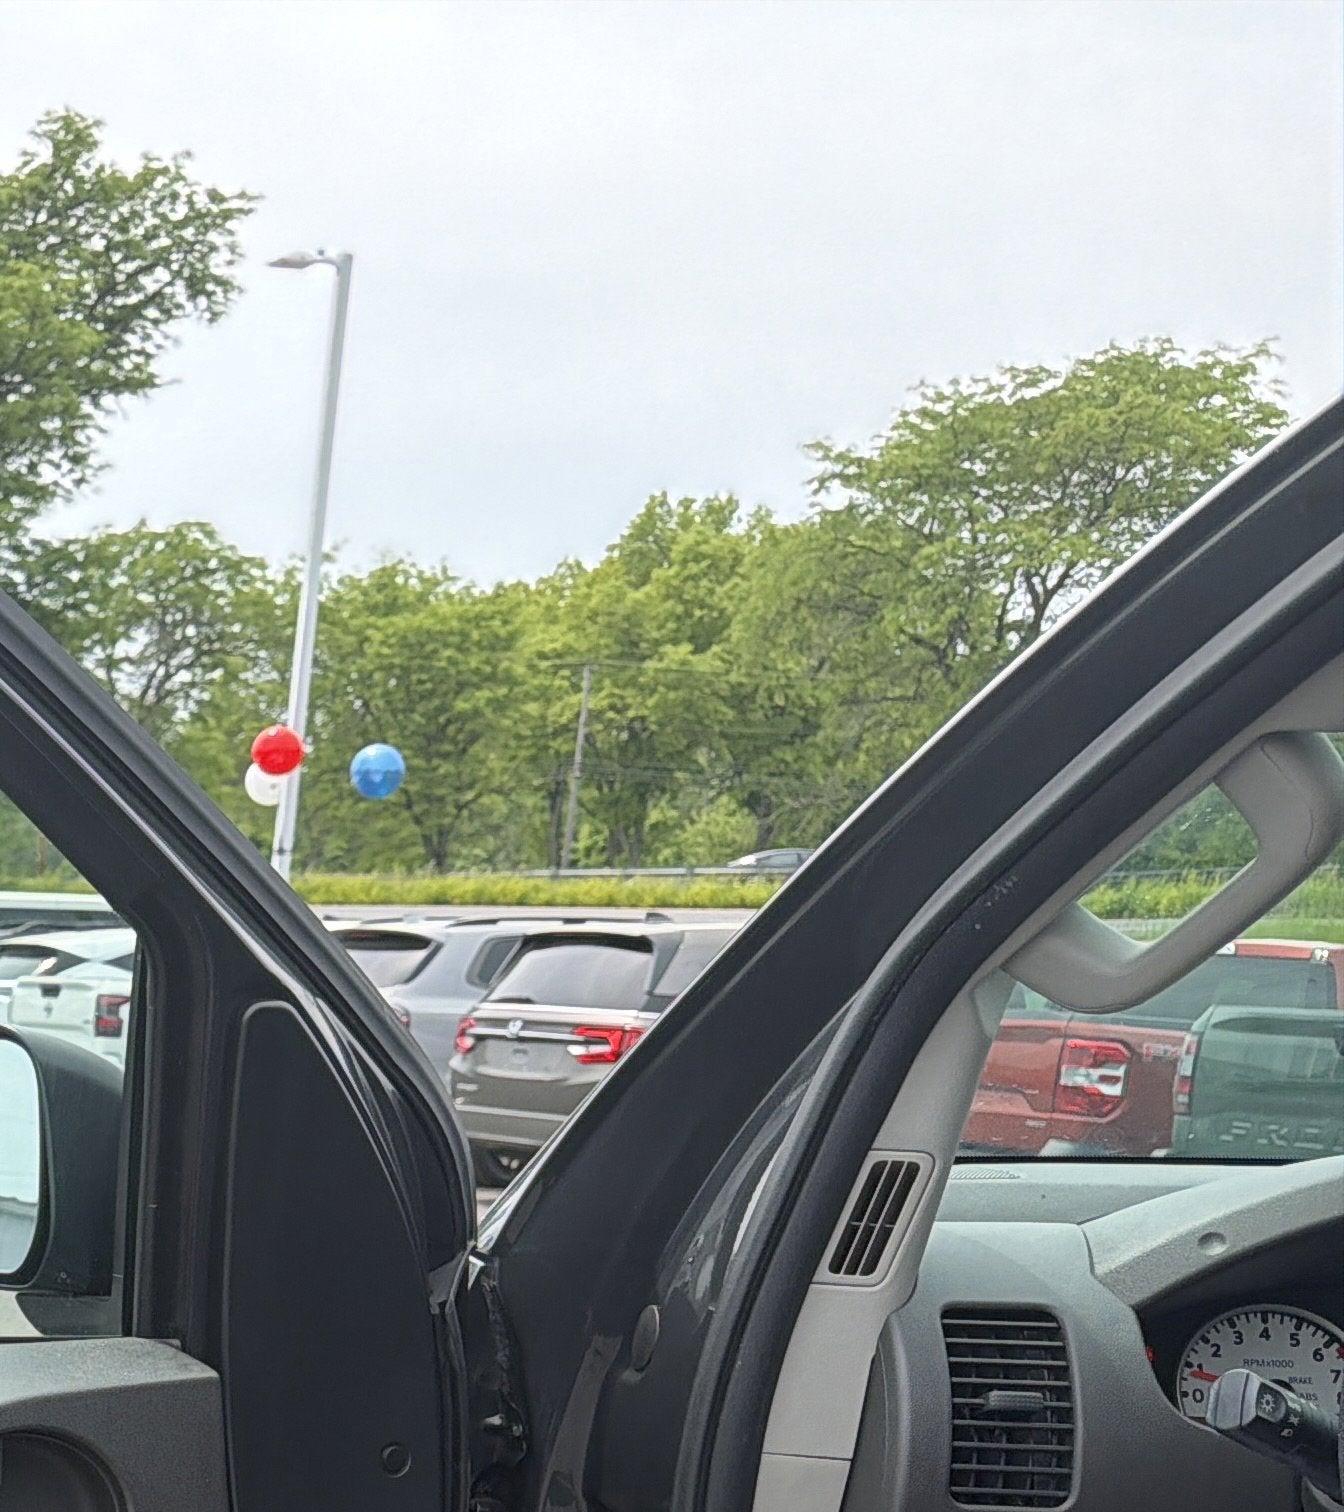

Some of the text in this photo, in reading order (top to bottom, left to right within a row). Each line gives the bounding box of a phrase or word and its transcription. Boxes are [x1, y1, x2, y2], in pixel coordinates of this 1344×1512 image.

[1232, 1330, 1244, 1345] 3
[1259, 1327, 1271, 1341] 4
[1289, 1333, 1301, 1347] 5
[1210, 1343, 1222, 1358] 2
[1312, 1348, 1325, 1362] 6
[1288, 1376, 1313, 1384] BRAKE
[1330, 1369, 1342, 1384] 7
[1192, 1388, 1205, 1403] 0
